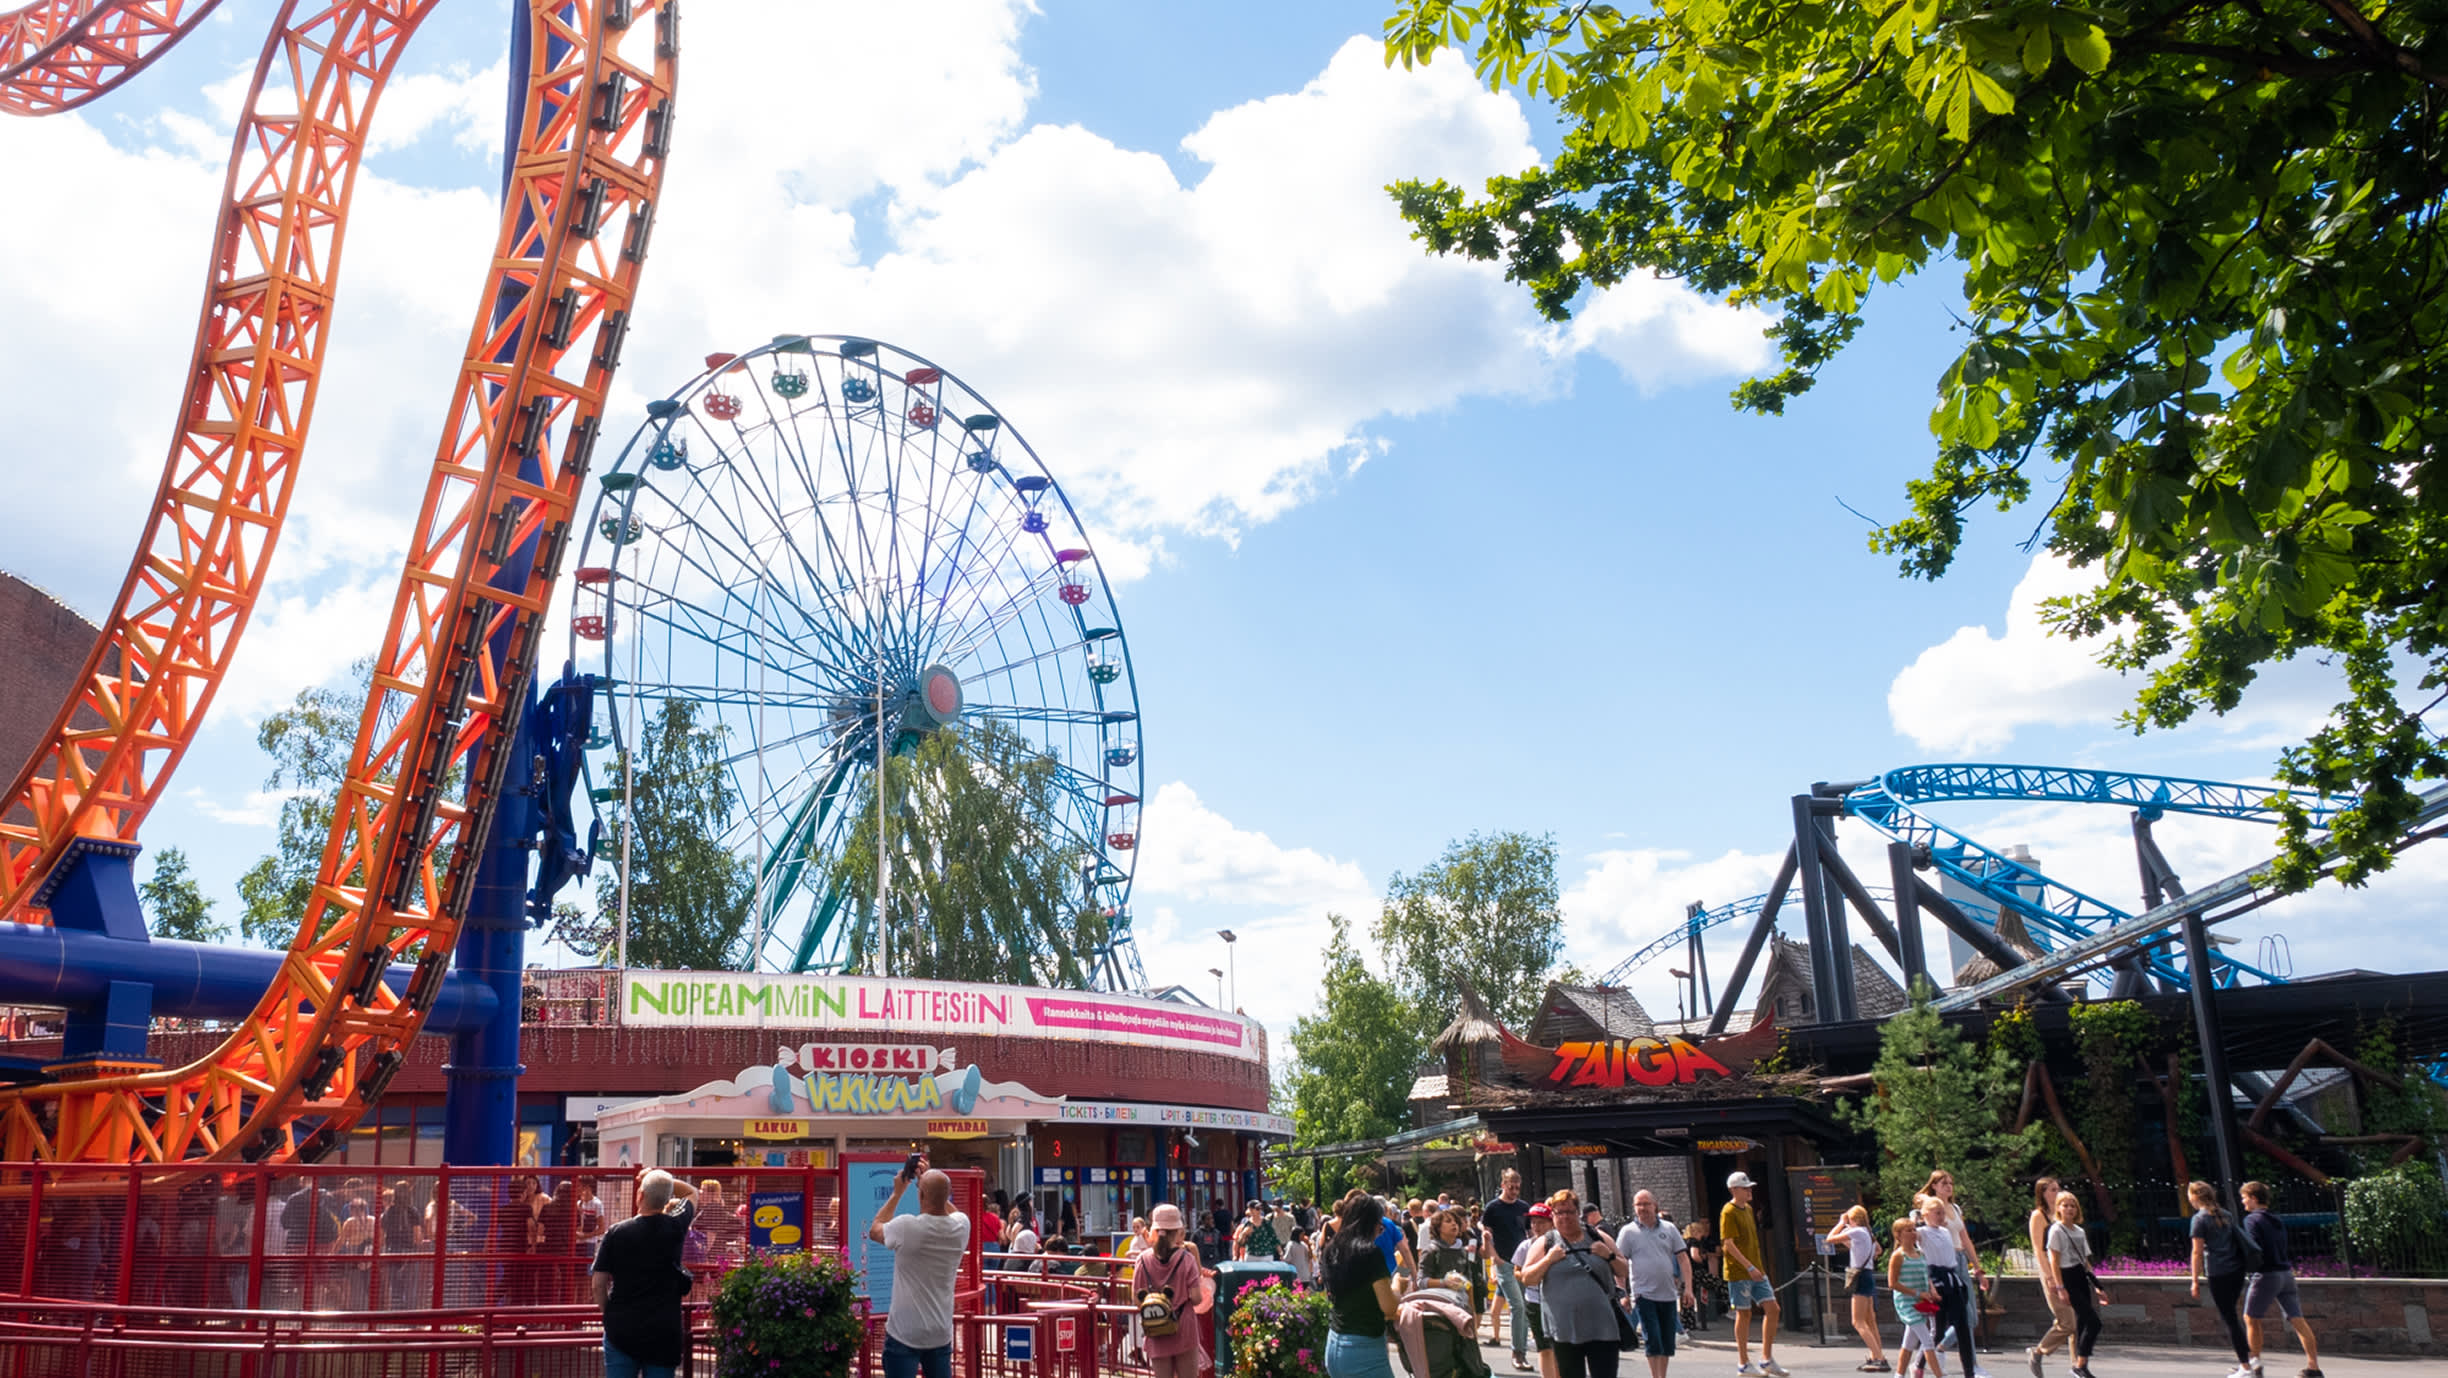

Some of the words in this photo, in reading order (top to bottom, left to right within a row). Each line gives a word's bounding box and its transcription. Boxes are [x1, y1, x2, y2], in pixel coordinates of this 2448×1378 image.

[1096, 1011, 1103, 1021] &
[812, 1047, 927, 1069] KIOSKI
[1550, 1035, 1731, 1088] TAIGA
[804, 1072, 942, 1113] VEKKULA
[754, 1122, 798, 1133] LAKUA
[928, 1120, 987, 1133] HATTARAA
[1053, 1140, 1061, 1157] 3
[1059, 1330, 1073, 1340] STOP
